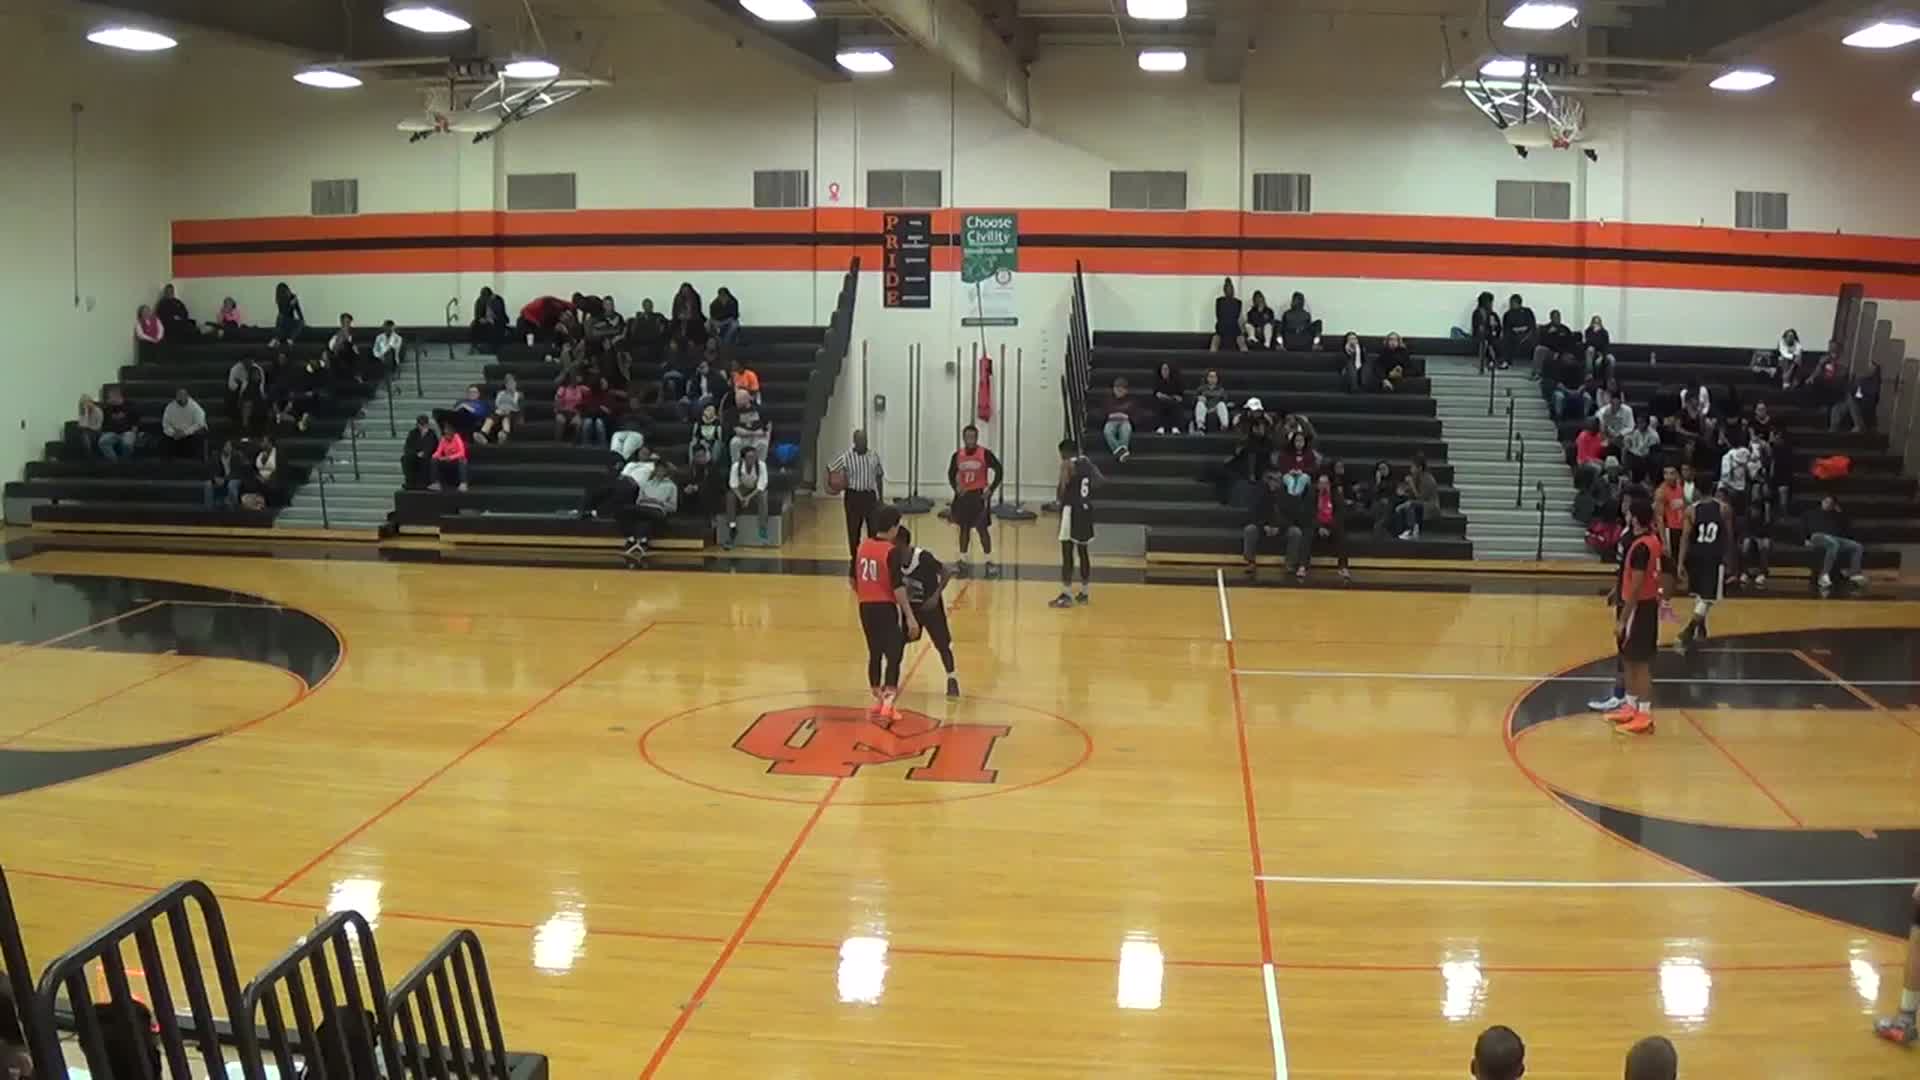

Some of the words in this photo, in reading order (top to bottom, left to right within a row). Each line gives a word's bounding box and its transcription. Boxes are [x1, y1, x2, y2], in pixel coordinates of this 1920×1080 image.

[966, 215, 1013, 229] Choose
[967, 230, 1010, 246] Civility
[886, 215, 899, 306] PRIDE
[1081, 477, 1089, 497] 6
[1697, 522, 1718, 543] 10
[860, 557, 878, 581] 20
